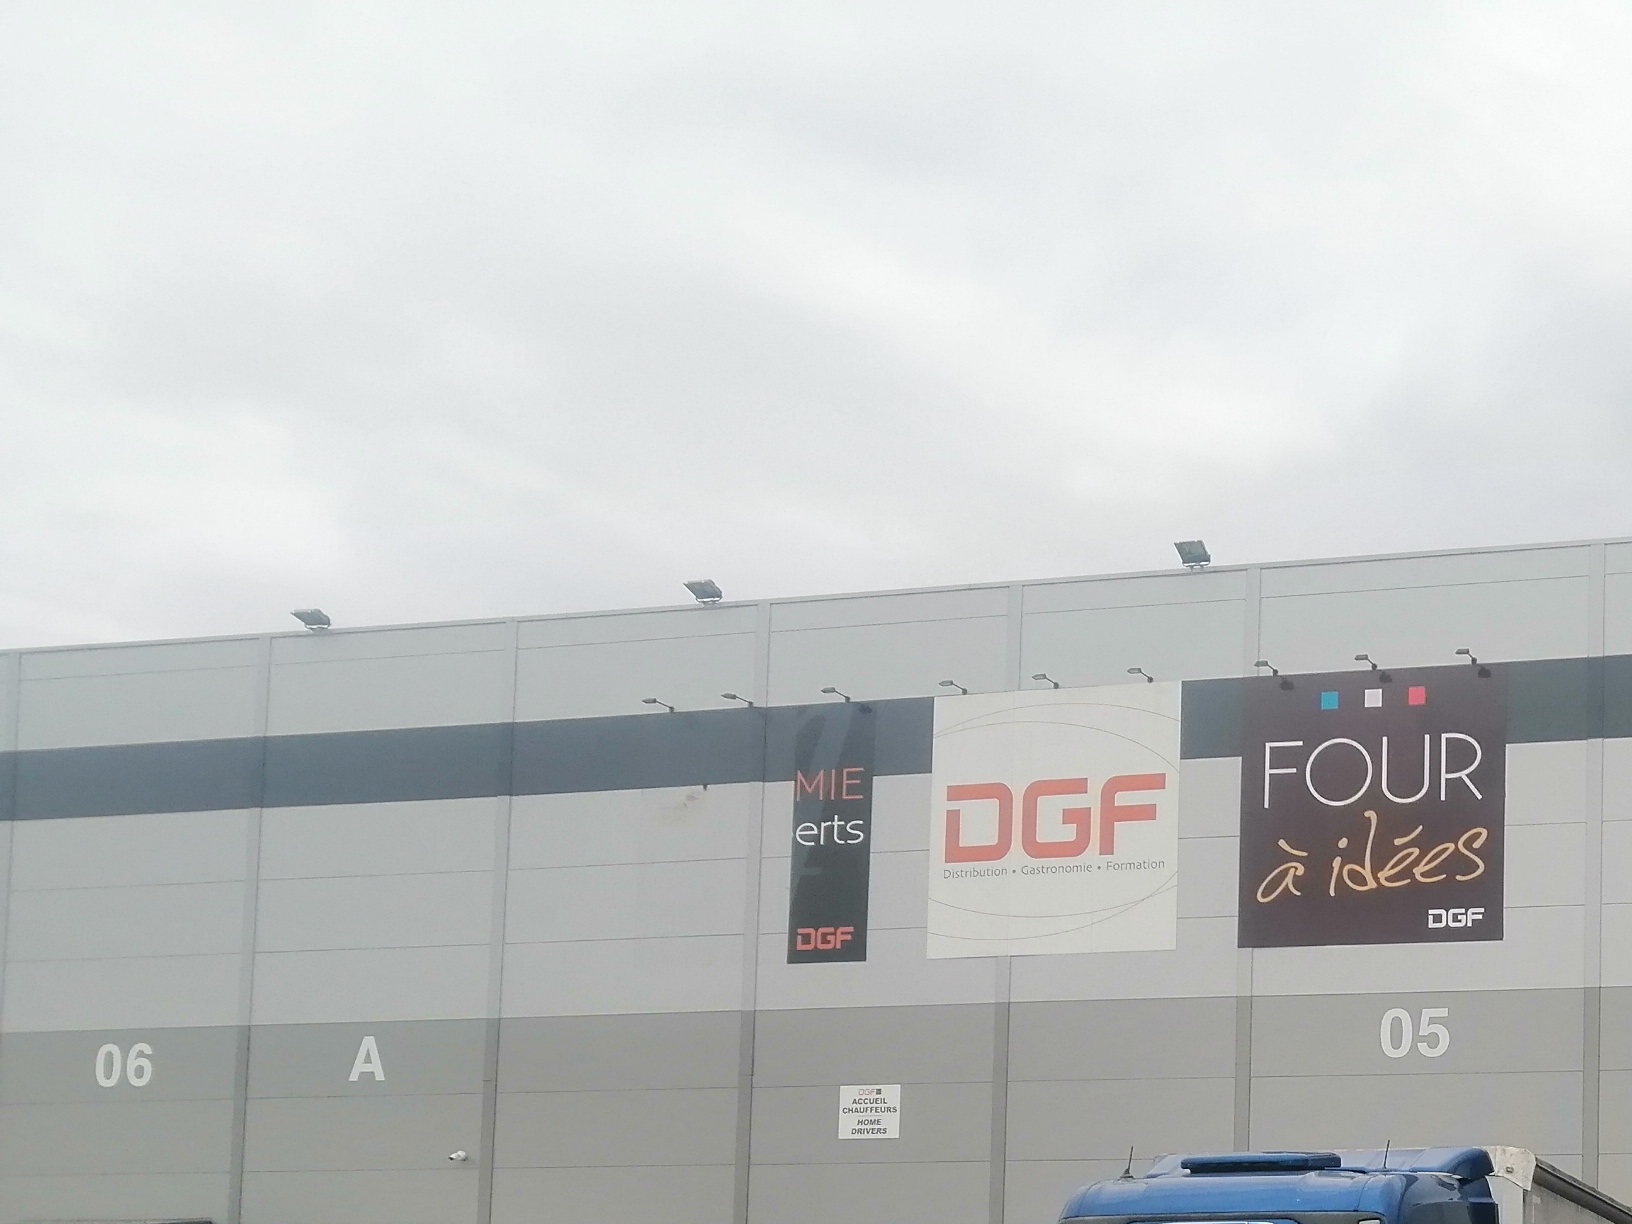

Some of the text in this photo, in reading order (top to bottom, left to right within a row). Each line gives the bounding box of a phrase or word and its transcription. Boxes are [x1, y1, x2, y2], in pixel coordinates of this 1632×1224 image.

[796, 767, 865, 802] MIE
[1263, 732, 1484, 809] FOUR
[944, 773, 1167, 864] DGF
[943, 859, 1166, 880] Distribution Gastronomie Formation
[1256, 809, 1489, 903] à idées
[1428, 907, 1485, 929] DGF
[796, 926, 855, 951] DGF
[1379, 1006, 1451, 1058] 05
[94, 1042, 155, 1088] 06
[348, 1035, 386, 1082] A
[842, 1106, 898, 1114] CHAUFFEURS
[851, 1097, 888, 1105] ACCUEIL
[851, 1127, 888, 1135] DRIVERS
[857, 1118, 882, 1126] HOME
